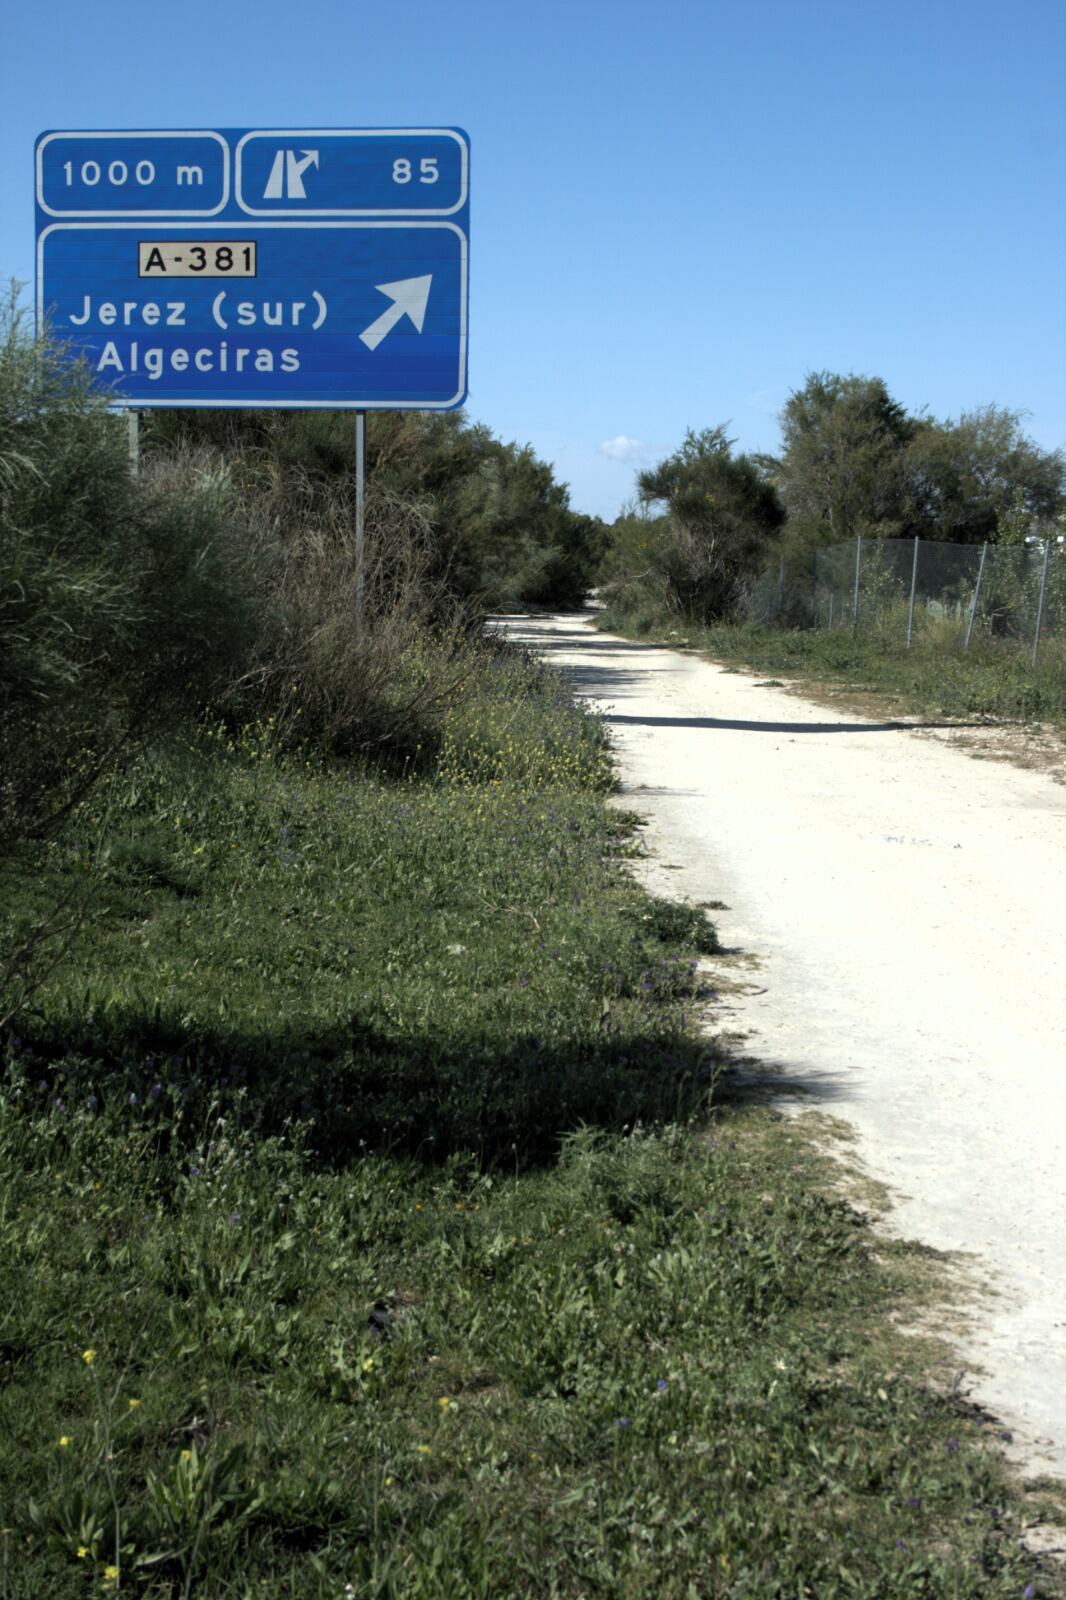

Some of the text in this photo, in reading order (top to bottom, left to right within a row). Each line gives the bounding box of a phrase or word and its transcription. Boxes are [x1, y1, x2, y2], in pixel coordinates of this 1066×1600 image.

[63, 160, 203, 187] 1000 m
[391, 157, 440, 184] 85
[144, 246, 252, 273] A-381
[69, 290, 327, 330] Jerez (sur)
[97, 341, 301, 380] Algeciras
